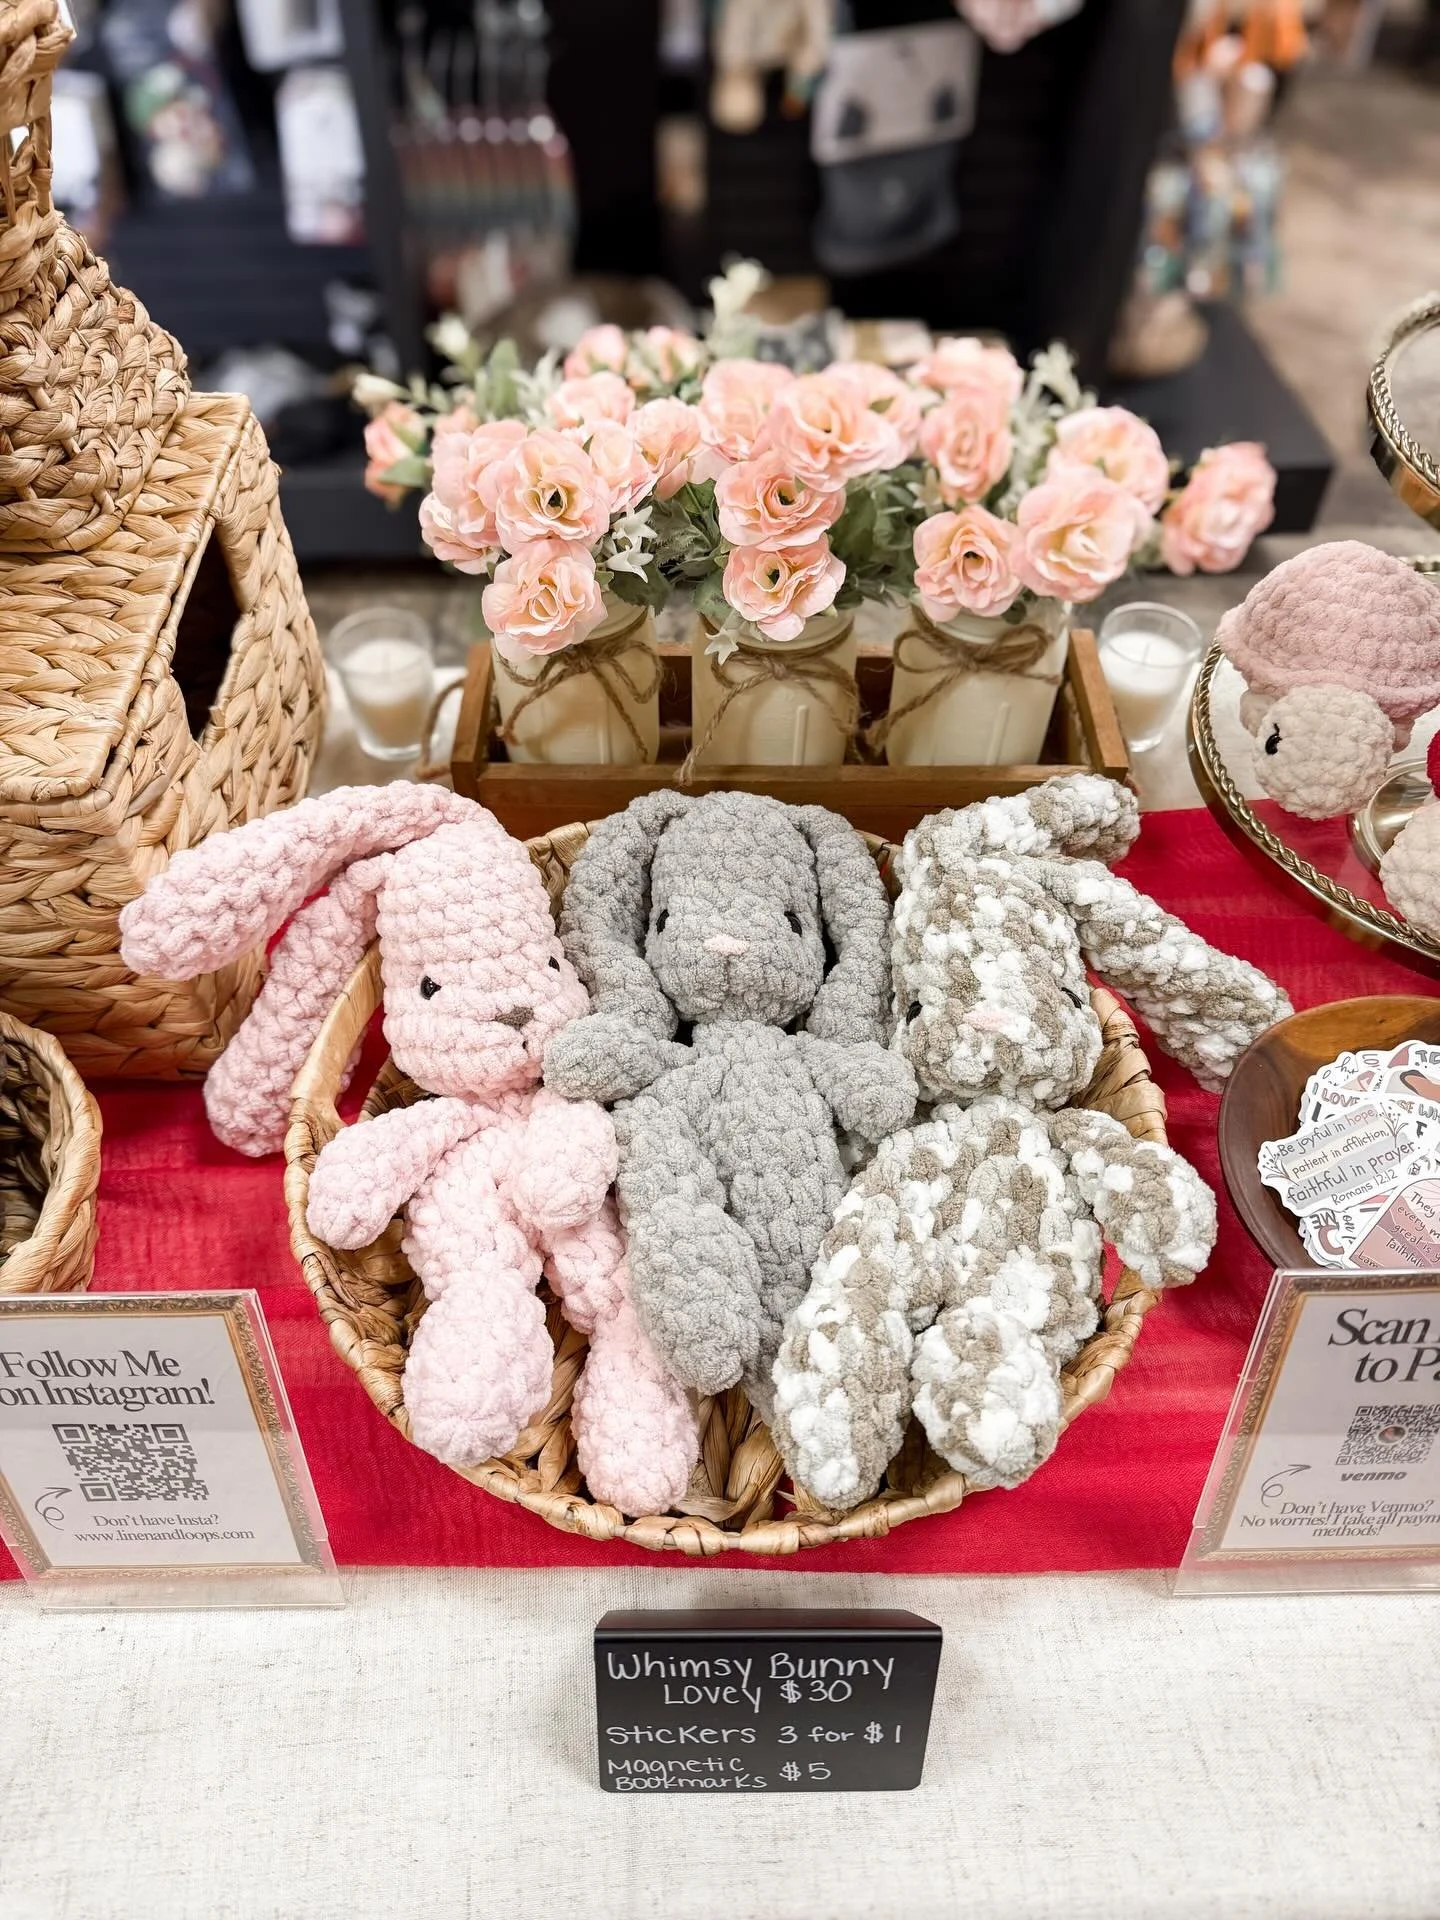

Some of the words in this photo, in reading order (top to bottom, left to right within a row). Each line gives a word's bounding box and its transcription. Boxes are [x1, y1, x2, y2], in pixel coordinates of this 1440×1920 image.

[1277, 1144, 1294, 1157] Be
[1298, 1126, 1332, 1154] joyful
[1333, 1123, 1346, 1134] in
[1292, 1152, 1329, 1179] patient
[1332, 1149, 1342, 1158] in
[1287, 1166, 1348, 1204] faithful
[1350, 1164, 1366, 1177] in
[1331, 1183, 1373, 1206] Romans
[1373, 1169, 1398, 1187] 12:12
[1411, 1191, 1436, 1218] They
[1397, 1207, 1426, 1232] every
[1390, 1225, 1424, 1246] great
[1422, 1243, 1432, 1254] is
[1327, 1308, 1431, 1346] Scan
[0, 1350, 119, 1378] Follow
[120, 1350, 183, 1377] Me
[1355, 1351, 1399, 1383] to
[0, 1386, 42, 1405] on
[36, 1378, 216, 1412] Instagram!
[1340, 1471, 1408, 1482] venmo
[140, 1515, 177, 1526] have
[176, 1514, 219, 1526] Insta?
[1240, 1515, 1266, 1528] No
[1269, 1514, 1331, 1526] worries!
[1332, 1514, 1341, 1525] I
[1342, 1513, 1375, 1525] take
[1376, 1512, 1399, 1525] all
[1329, 1502, 1366, 1515] have
[1371, 1500, 1434, 1514] Venmo?
[74, 1529, 256, 1543] www.linenandloops.com
[1312, 1525, 1384, 1537] methods!
[607, 1652, 753, 1689] Whimsy
[769, 1653, 895, 1690] Bunny
[664, 1683, 762, 1714] Lovey
[778, 1725, 798, 1745] 3
[808, 1726, 855, 1743] for
